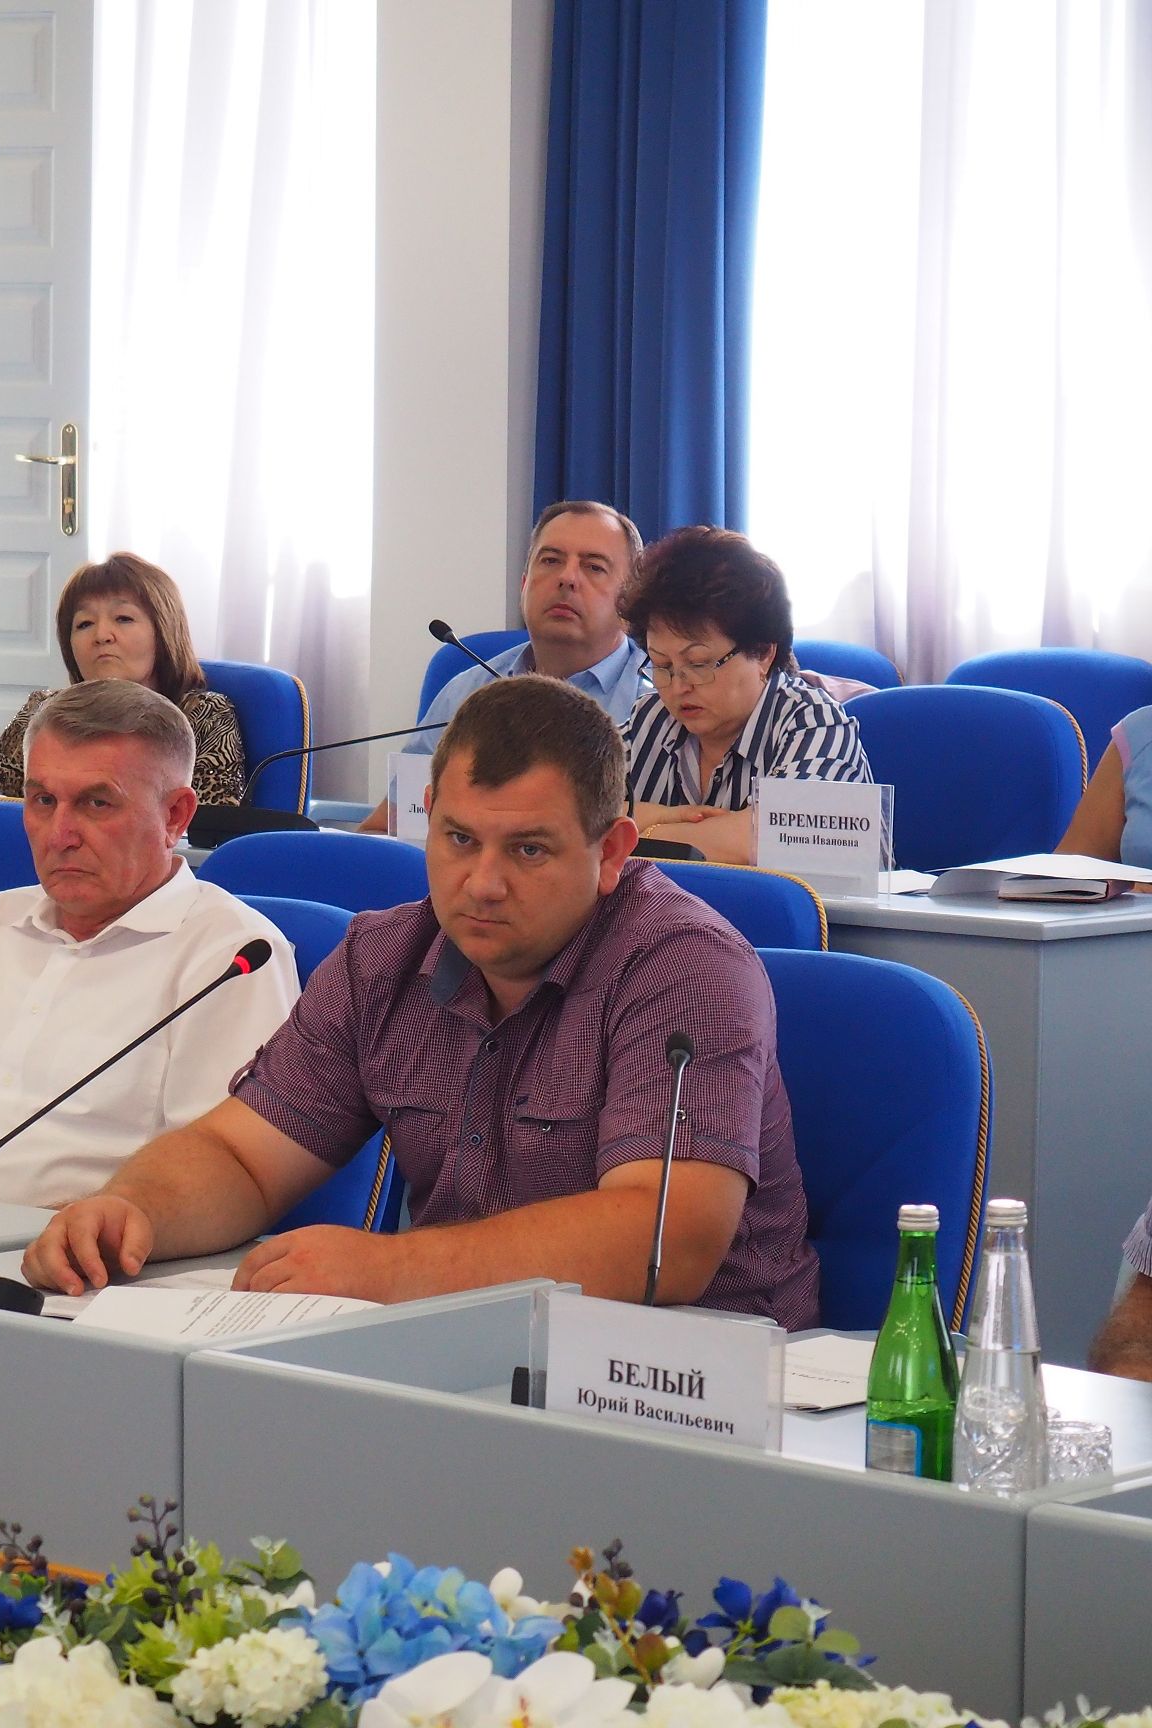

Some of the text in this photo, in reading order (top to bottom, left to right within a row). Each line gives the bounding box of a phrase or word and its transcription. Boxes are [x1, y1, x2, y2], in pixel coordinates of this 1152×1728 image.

[769, 812, 870, 832] ВЕРЕМЕЕНКО
[779, 833, 859, 848] Ирина Ивановна
[607, 1358, 707, 1401] БЕЛЫЙ
[577, 1387, 735, 1436] Юрий Васильевич
